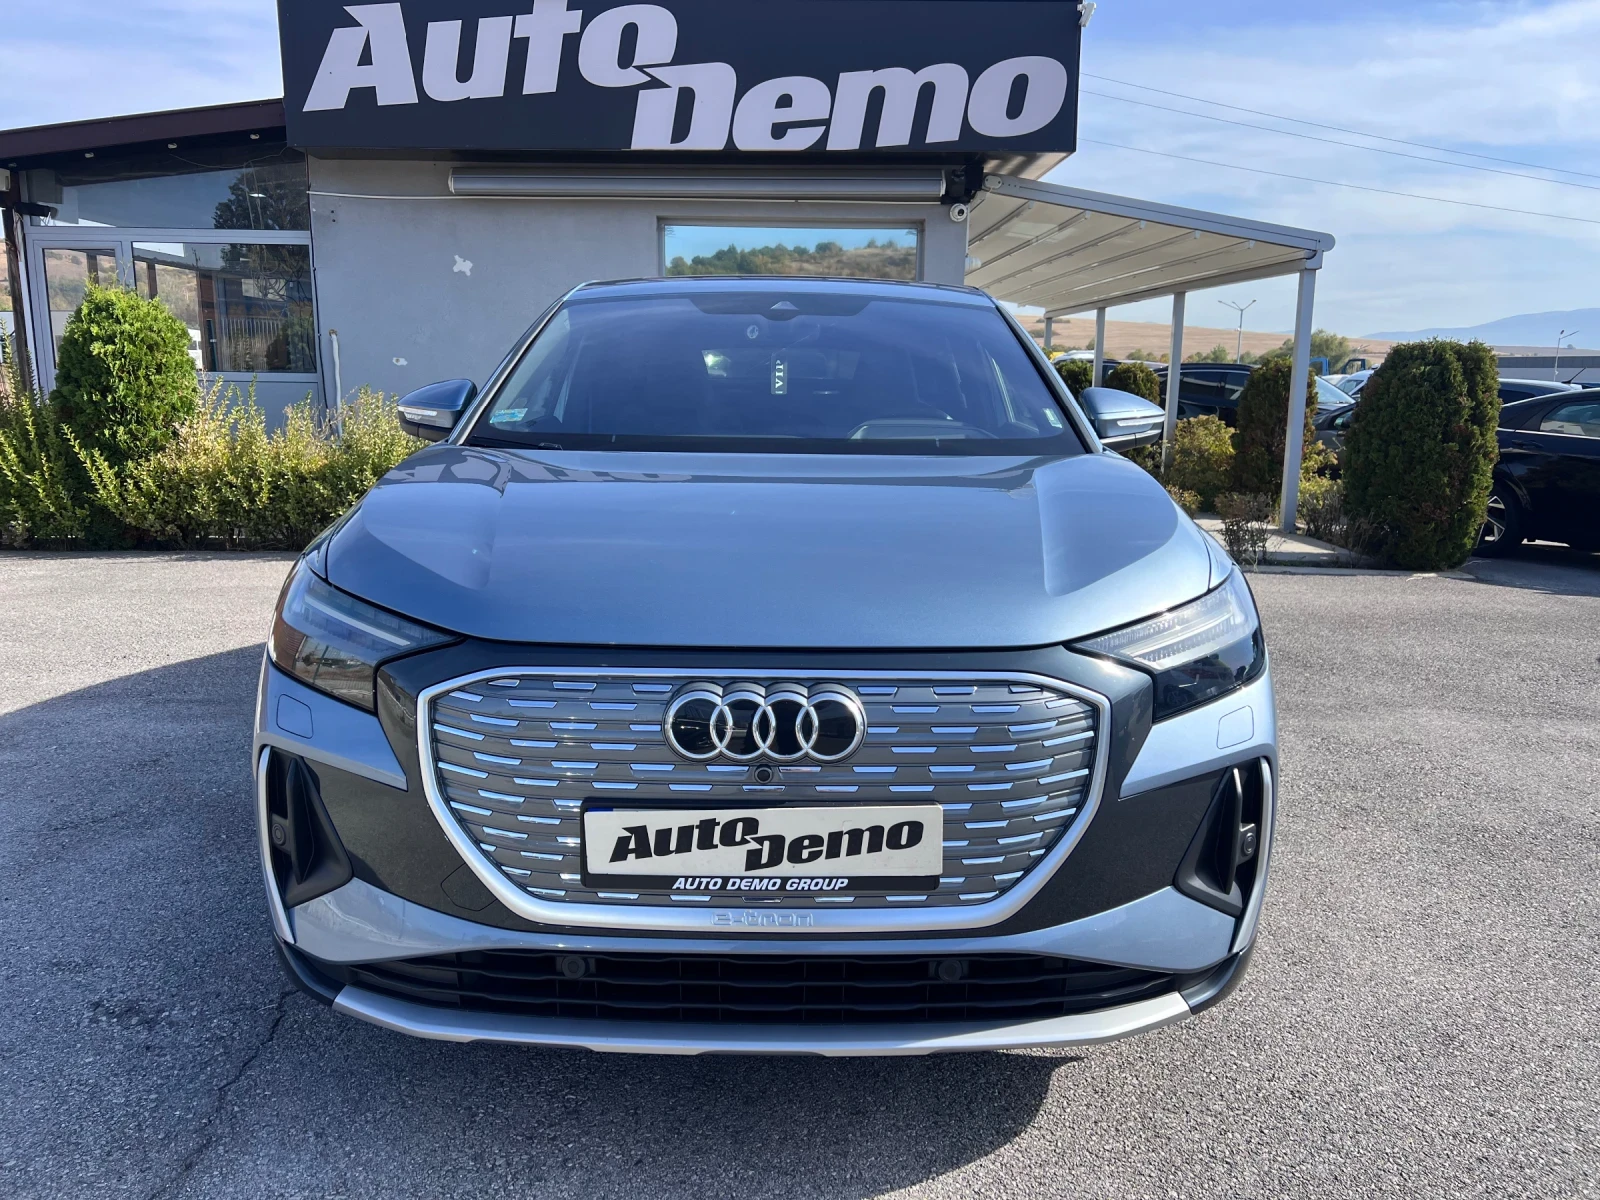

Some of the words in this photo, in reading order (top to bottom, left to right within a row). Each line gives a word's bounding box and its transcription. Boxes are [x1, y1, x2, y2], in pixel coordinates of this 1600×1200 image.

[301, 0, 678, 112] Auto
[630, 55, 1068, 152] Demo
[608, 816, 760, 863] Auto
[744, 820, 924, 872] Demo
[672, 877, 723, 891] AUTO
[726, 878, 781, 891] DEMO
[785, 878, 849, 891] GROUP
[711, 909, 814, 927] e-tron
